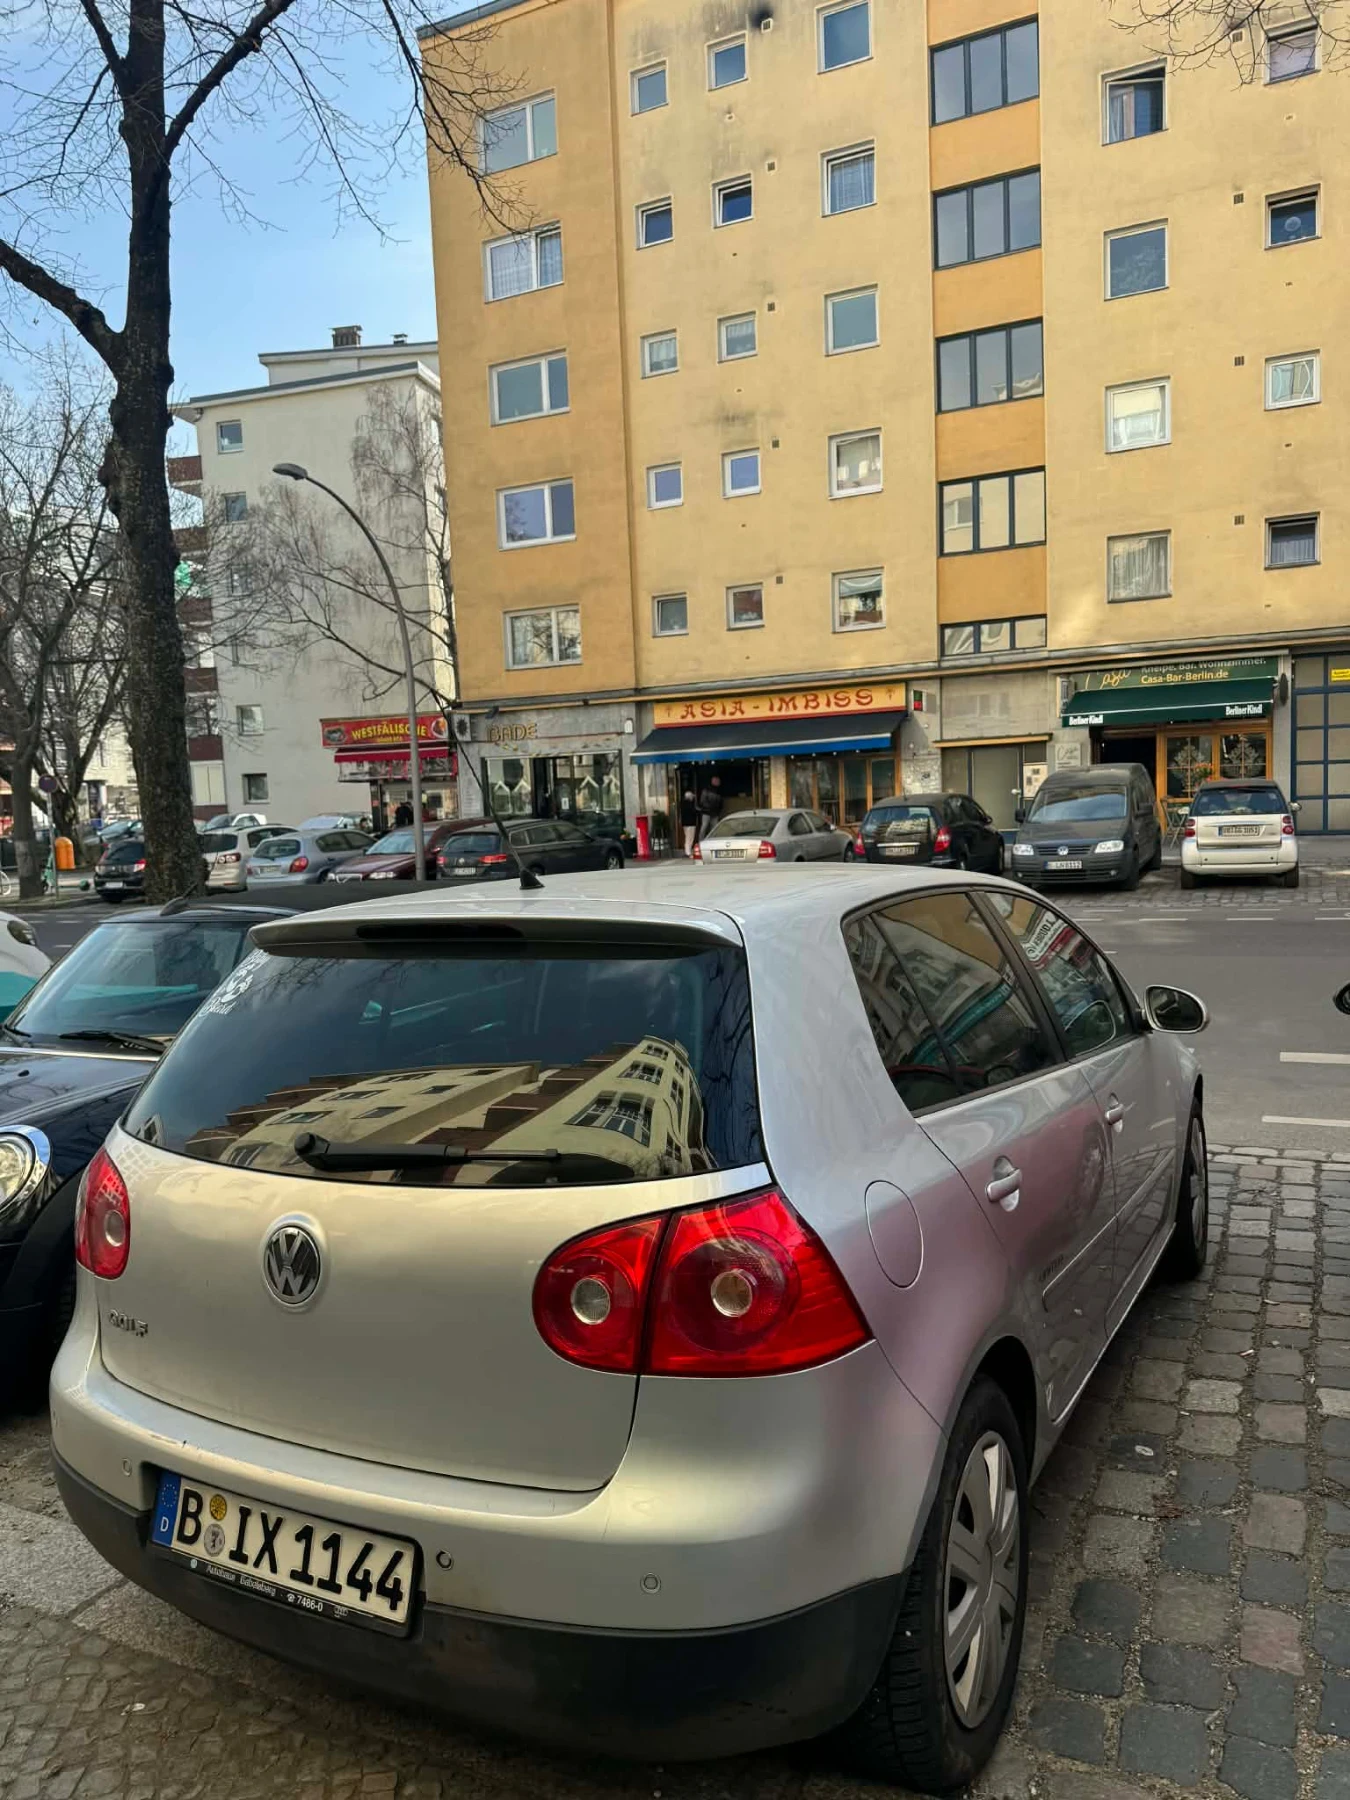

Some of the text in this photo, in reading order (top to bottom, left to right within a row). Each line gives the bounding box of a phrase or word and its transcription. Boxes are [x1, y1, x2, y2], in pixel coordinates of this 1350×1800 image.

[1140, 669, 1229, 685] Casa-Bar-Berlin.de
[680, 700, 745, 720] ASIA
[768, 688, 874, 713] IMBISS
[160, 1516, 169, 1533] D
[176, 1487, 204, 1546] B
[289, 1524, 404, 1611] 1144
[296, 1595, 324, 1612] 7486-0
